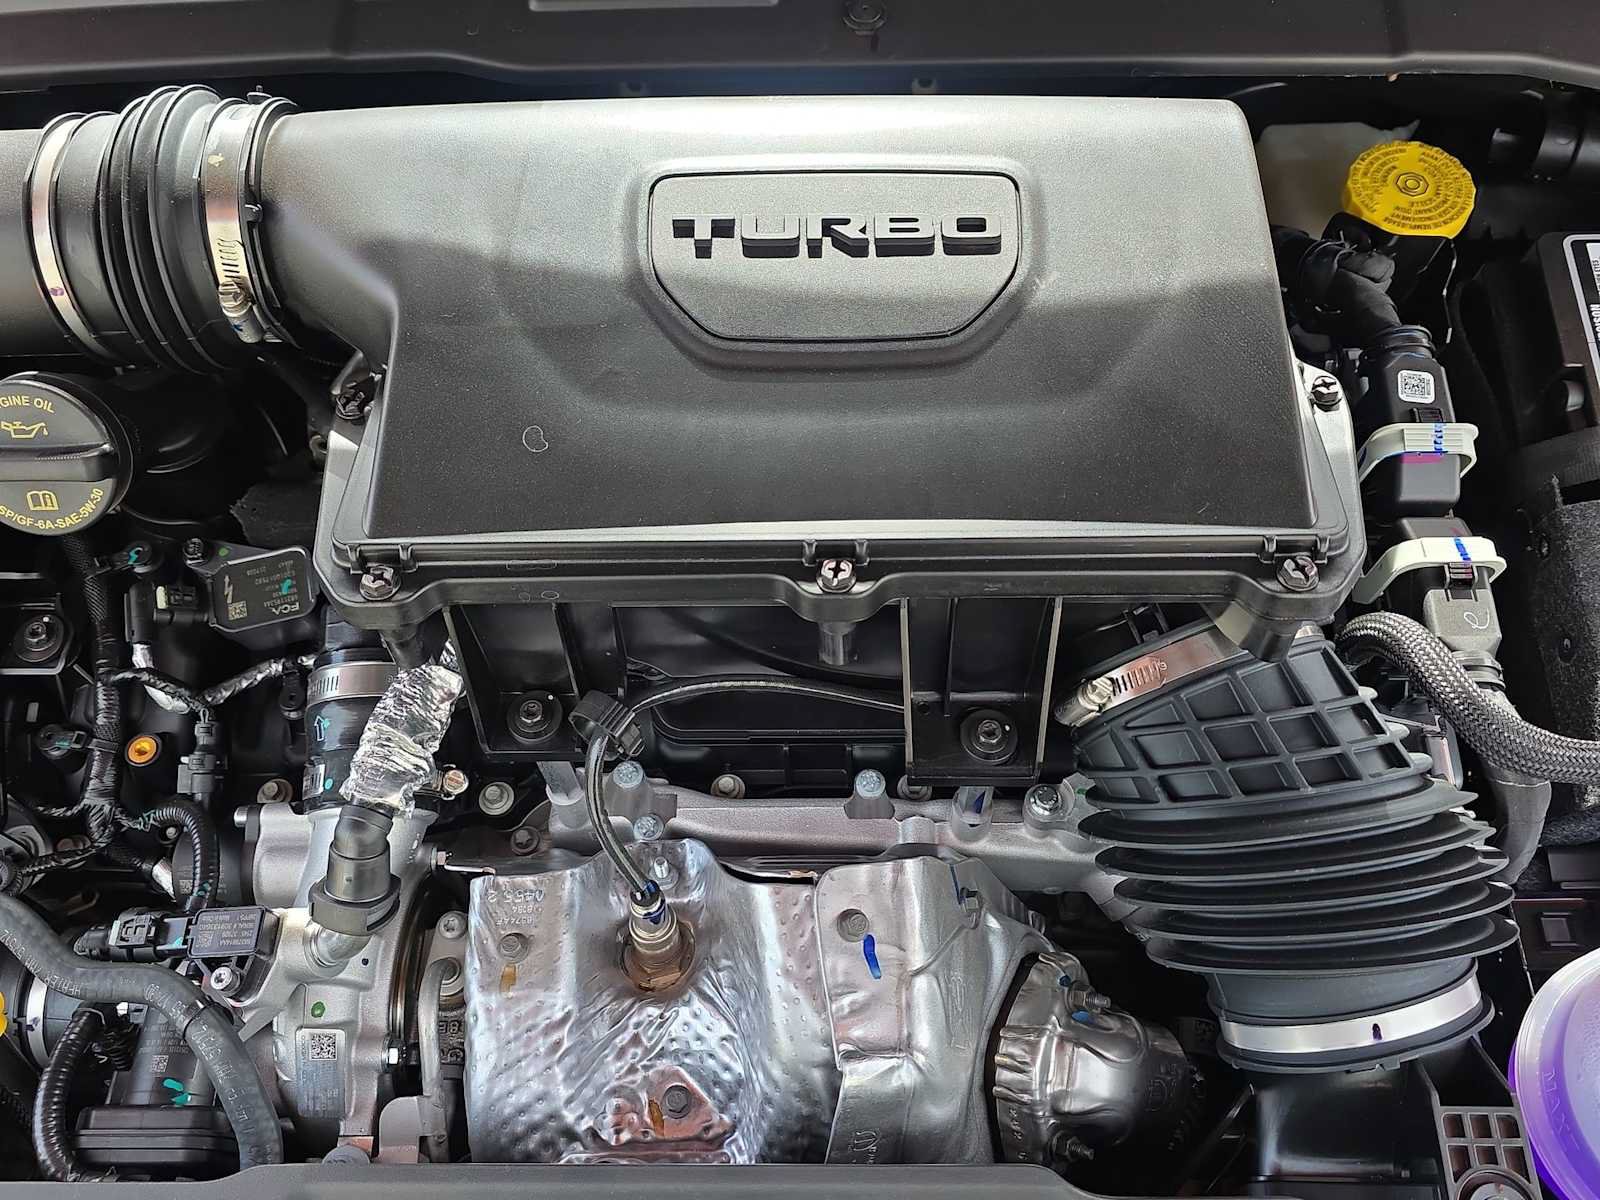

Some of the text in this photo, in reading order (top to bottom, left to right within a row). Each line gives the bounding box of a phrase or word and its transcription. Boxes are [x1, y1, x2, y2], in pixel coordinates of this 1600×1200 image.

[672, 213, 1002, 260] TURBO
[0, 395, 56, 414] GINE OIL
[272, 601, 301, 616] FCA
